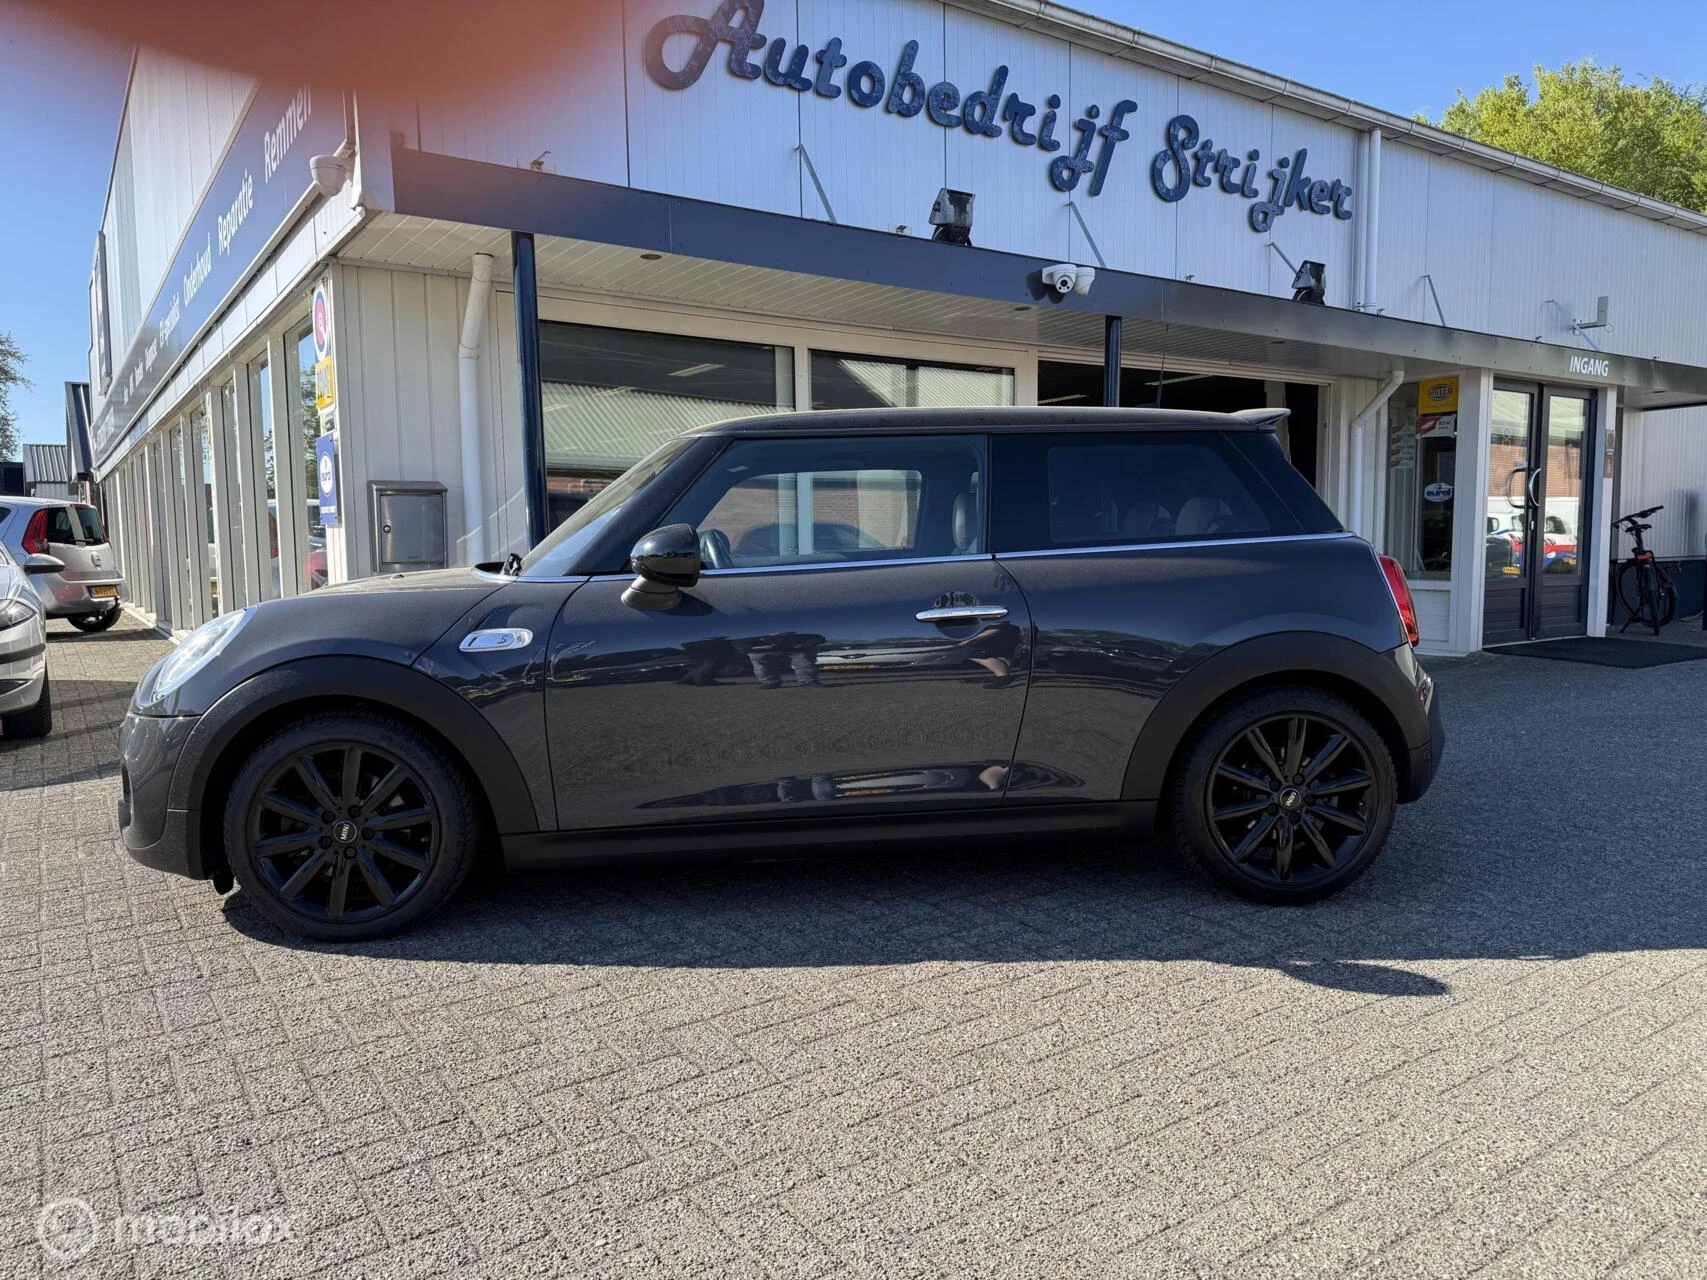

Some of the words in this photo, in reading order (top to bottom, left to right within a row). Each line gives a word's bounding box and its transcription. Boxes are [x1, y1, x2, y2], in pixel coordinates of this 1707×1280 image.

[644, 0, 1137, 196] Autobedrijf
[1152, 114, 1352, 233] Strijker
[184, 232, 211, 308] Onderhoud
[217, 168, 253, 256] Reparatie
[264, 84, 312, 184] Remmen
[1569, 355, 1609, 377] INGANG
[341, 824, 350, 840] MINI
